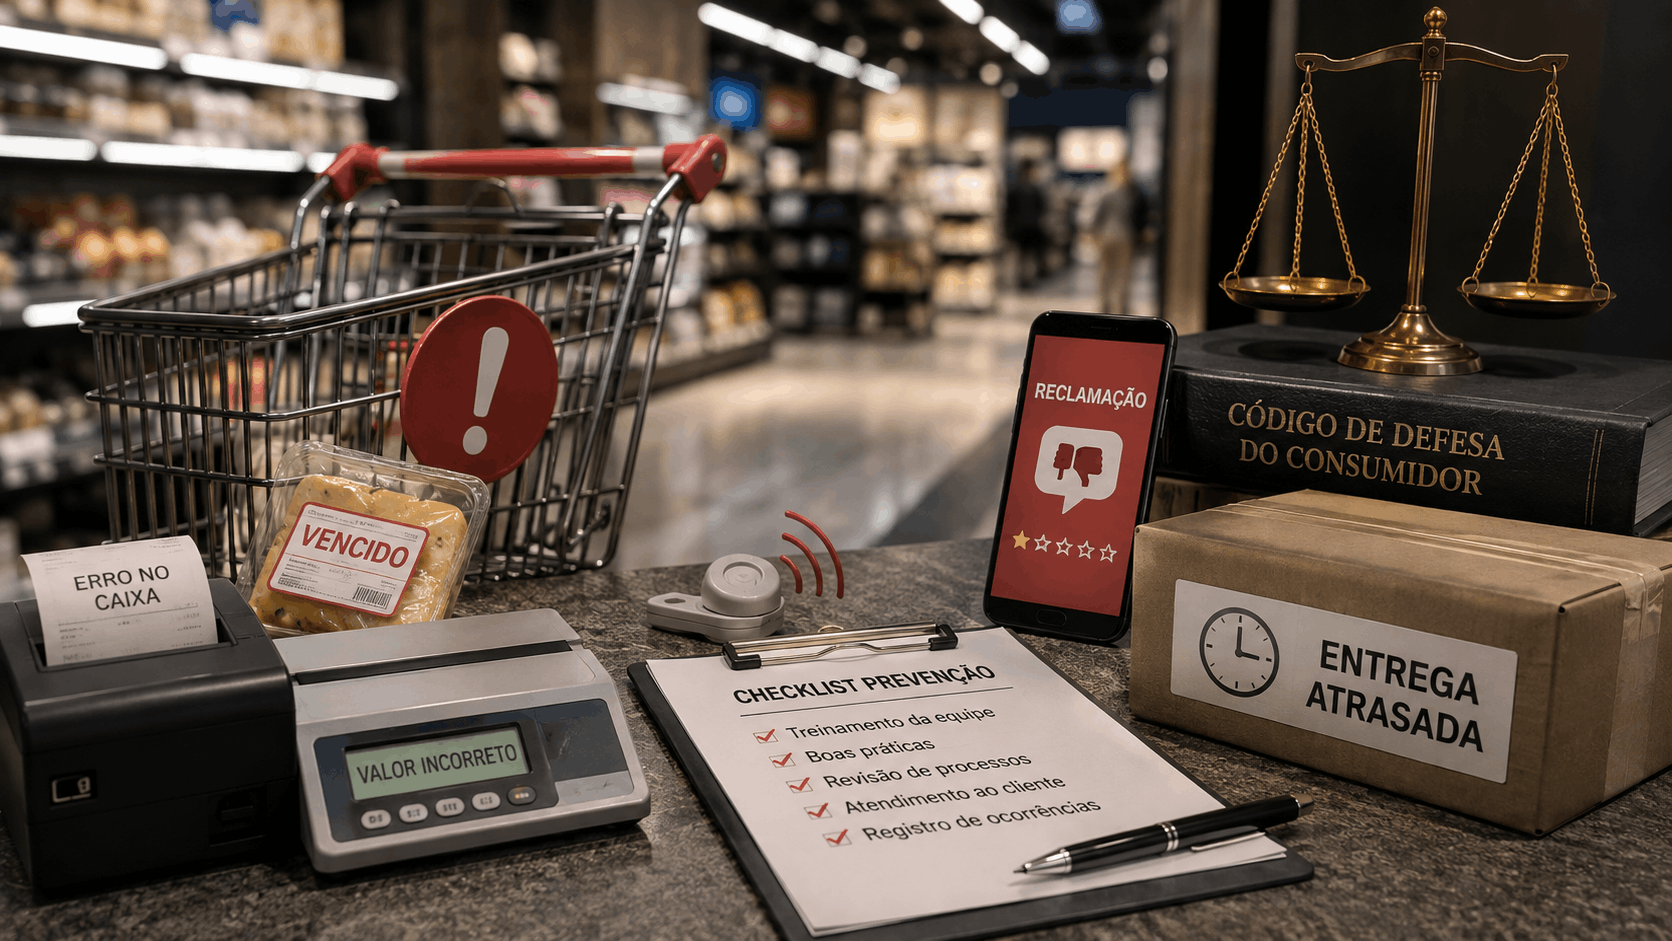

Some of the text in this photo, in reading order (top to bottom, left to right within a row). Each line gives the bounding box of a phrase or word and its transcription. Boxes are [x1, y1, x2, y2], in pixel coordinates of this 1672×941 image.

[1034, 382, 1147, 411] RECLAMAÇÃO
[1228, 399, 1505, 461] CÓDIGO DE DEFESA
[1239, 438, 1482, 496] DO CONSUMIDOR
[302, 524, 409, 568] VENCIDO
[74, 565, 170, 591] ERRO NO
[95, 587, 161, 611] CAIXA
[733, 664, 996, 704] CHECKLIST PREVENÇÃO
[1320, 639, 1479, 706] ENTREGA
[785, 706, 996, 739] Treinamento da equipe
[1305, 681, 1484, 753] ATRASADA
[356, 743, 518, 784] VALOR INCORRETO
[804, 738, 936, 764] Boas práticas
[823, 754, 1032, 788] Revisão de processos
[844, 775, 1066, 814] Atendimento ao cliente
[862, 799, 1101, 842] Registro de ocorrências
